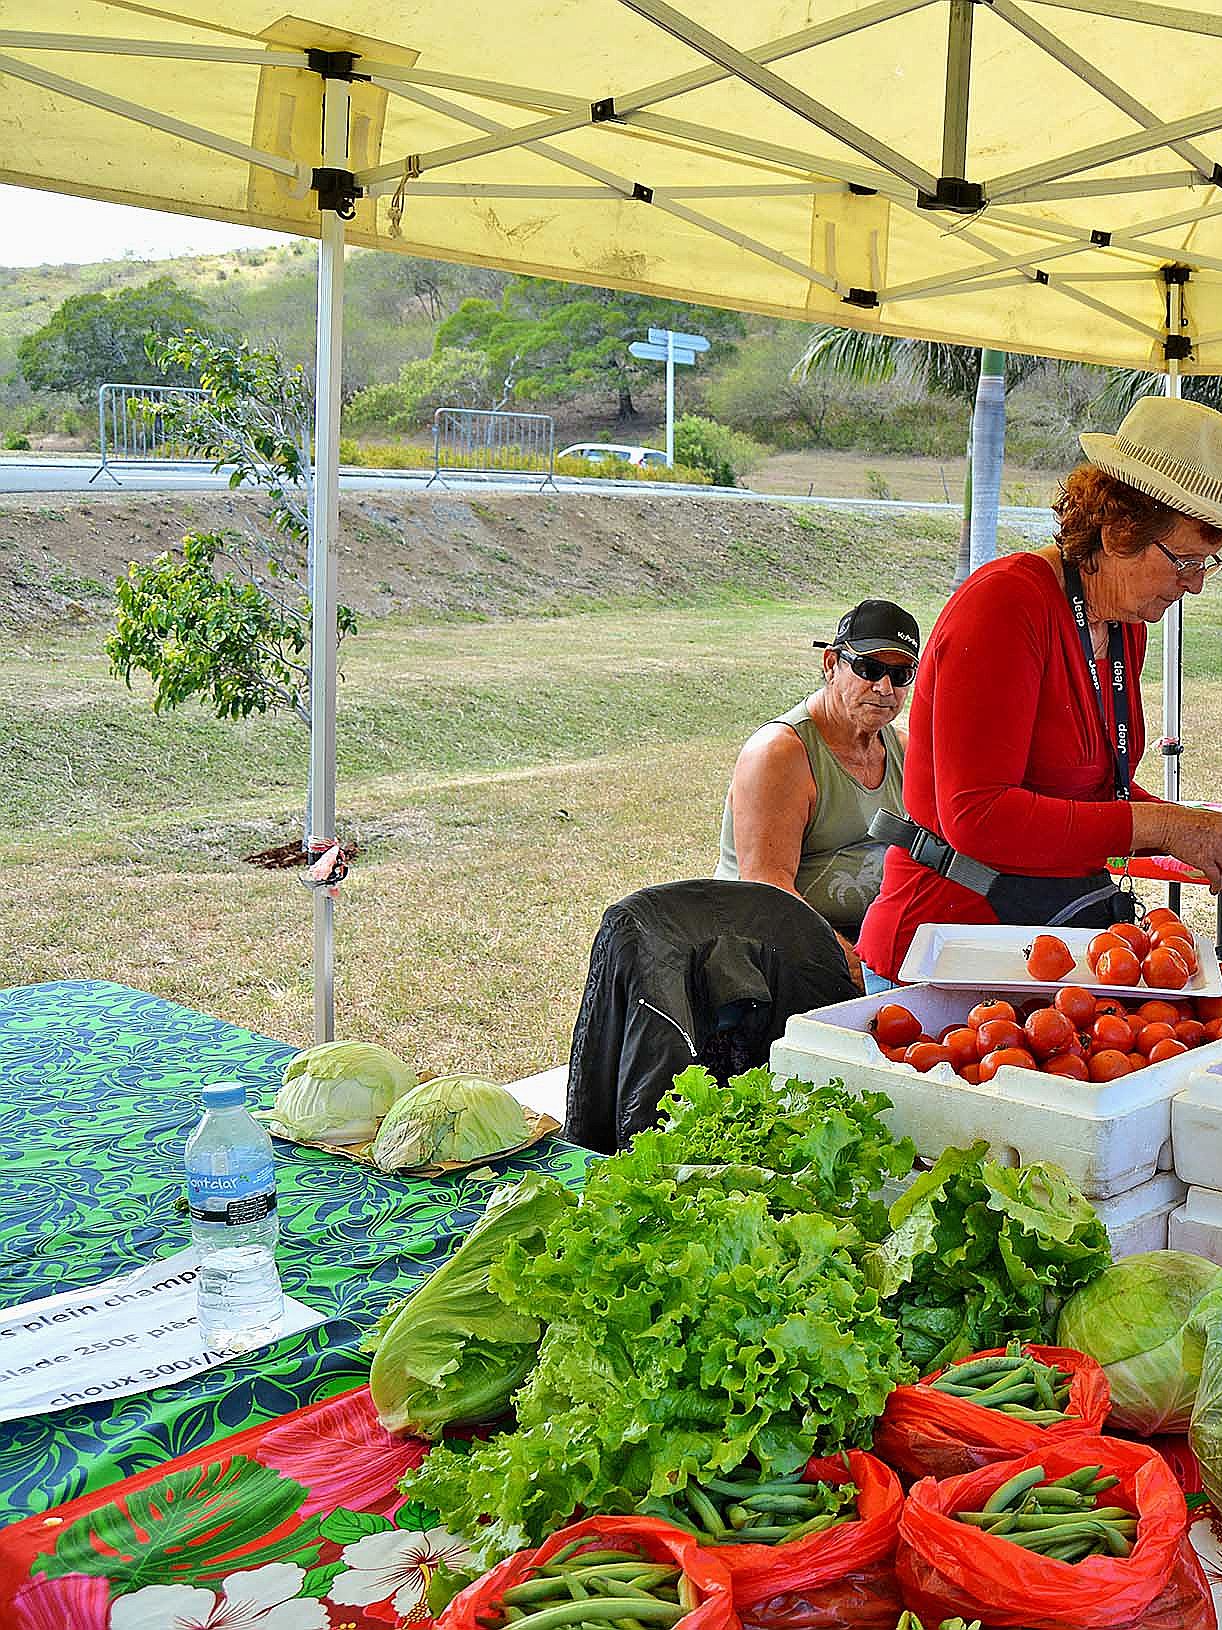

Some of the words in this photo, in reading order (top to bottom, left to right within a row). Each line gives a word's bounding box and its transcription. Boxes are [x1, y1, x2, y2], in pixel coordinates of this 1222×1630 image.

[1072, 596, 1086, 627] Jeep
[1088, 659, 1100, 690] Jeep
[1112, 661, 1125, 691] Jeep
[1117, 723, 1128, 754] Jeep
[23, 1304, 97, 1333] plein
[73, 1333, 140, 1356] 250F
[147, 1317, 199, 1338] pièc
[50, 1374, 139, 1406] choux
